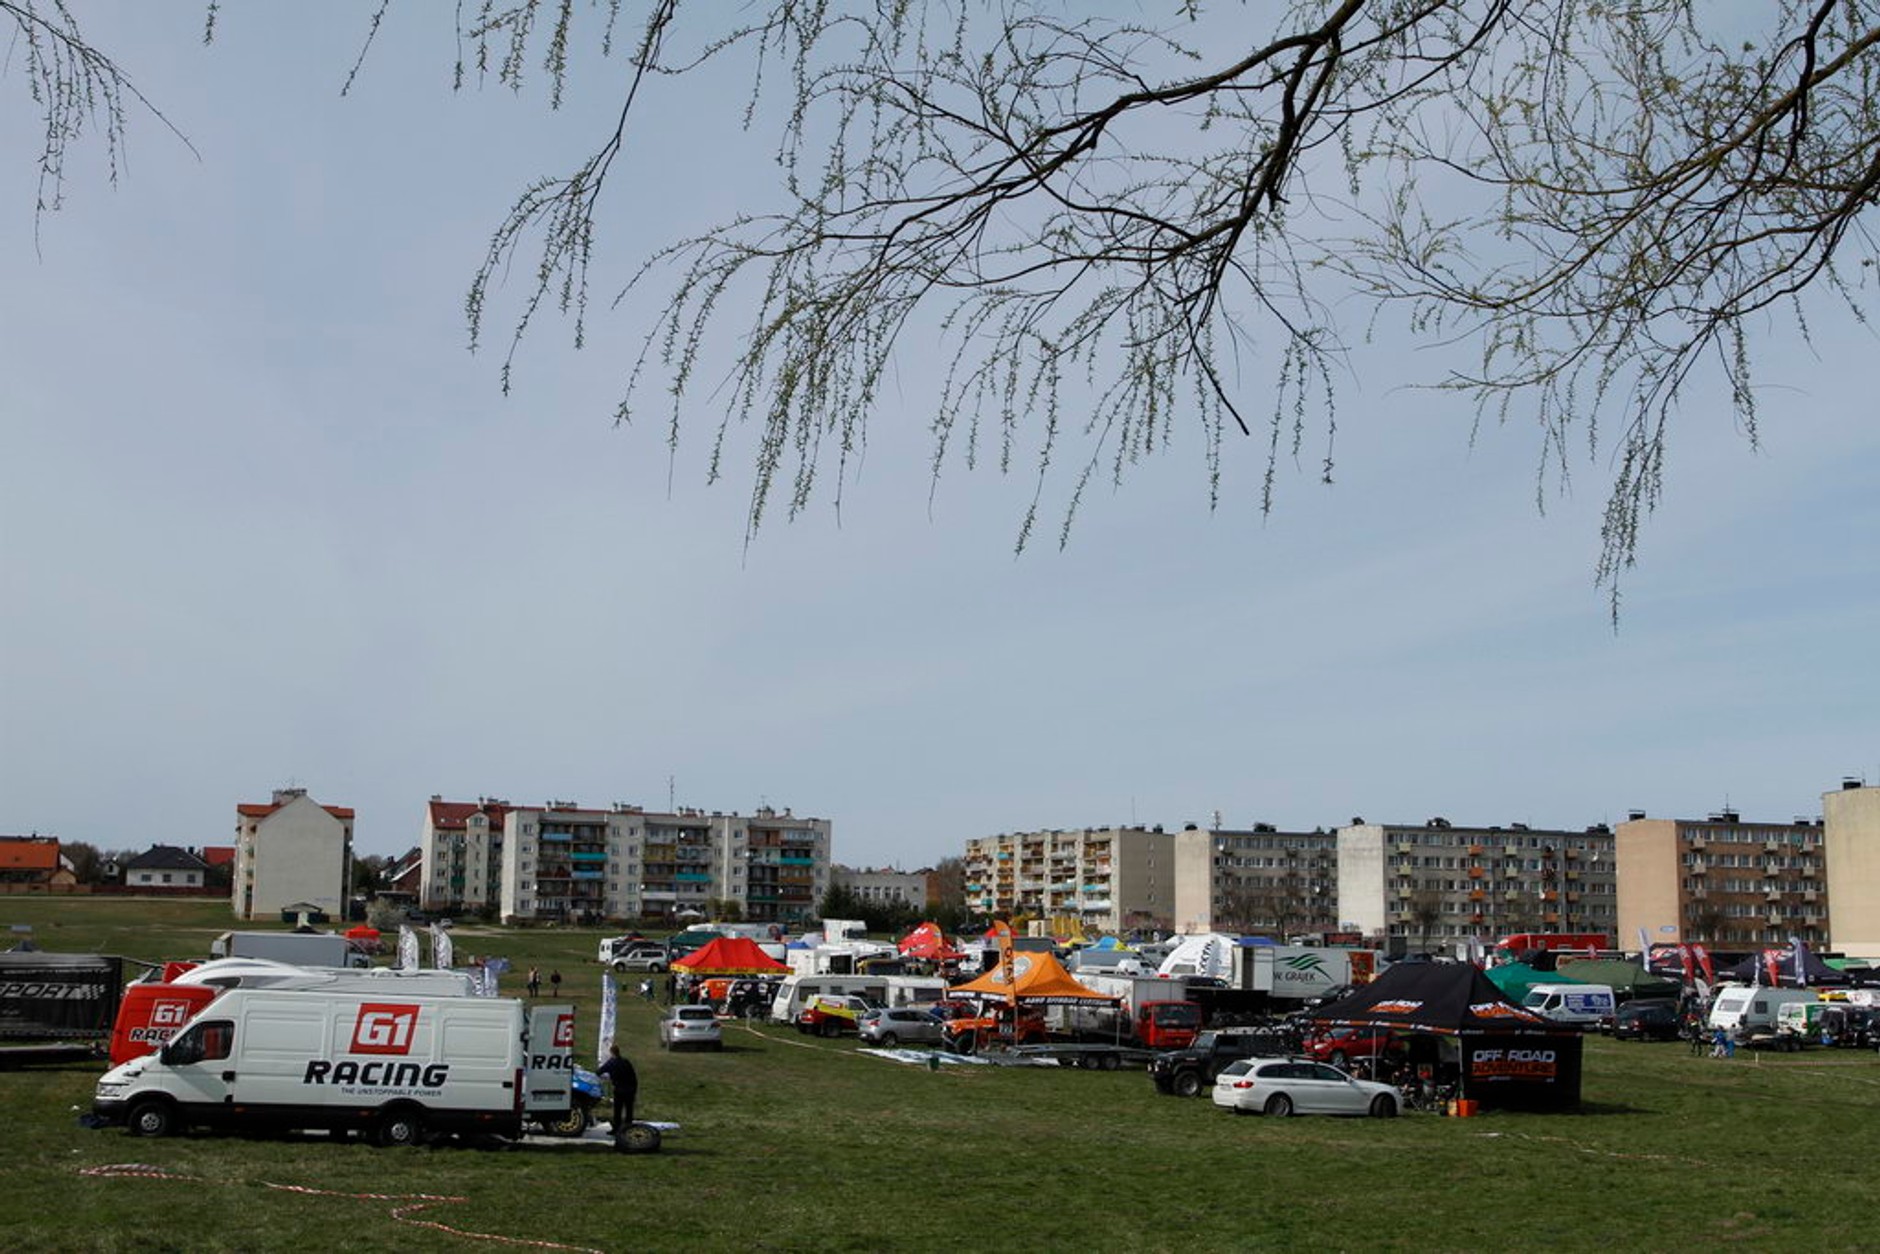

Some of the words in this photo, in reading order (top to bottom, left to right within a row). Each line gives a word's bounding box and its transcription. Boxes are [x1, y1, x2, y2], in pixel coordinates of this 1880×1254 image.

[154, 1004, 185, 1024] G1
[357, 1011, 413, 1046] G1
[1473, 1049, 1503, 1062] OFF
[1507, 1049, 1556, 1063] ROAD
[303, 1060, 449, 1088] RACING
[341, 1086, 356, 1095] THE
[357, 1087, 412, 1097] UNSTOPPABLE
[413, 1089, 442, 1097] POWER
